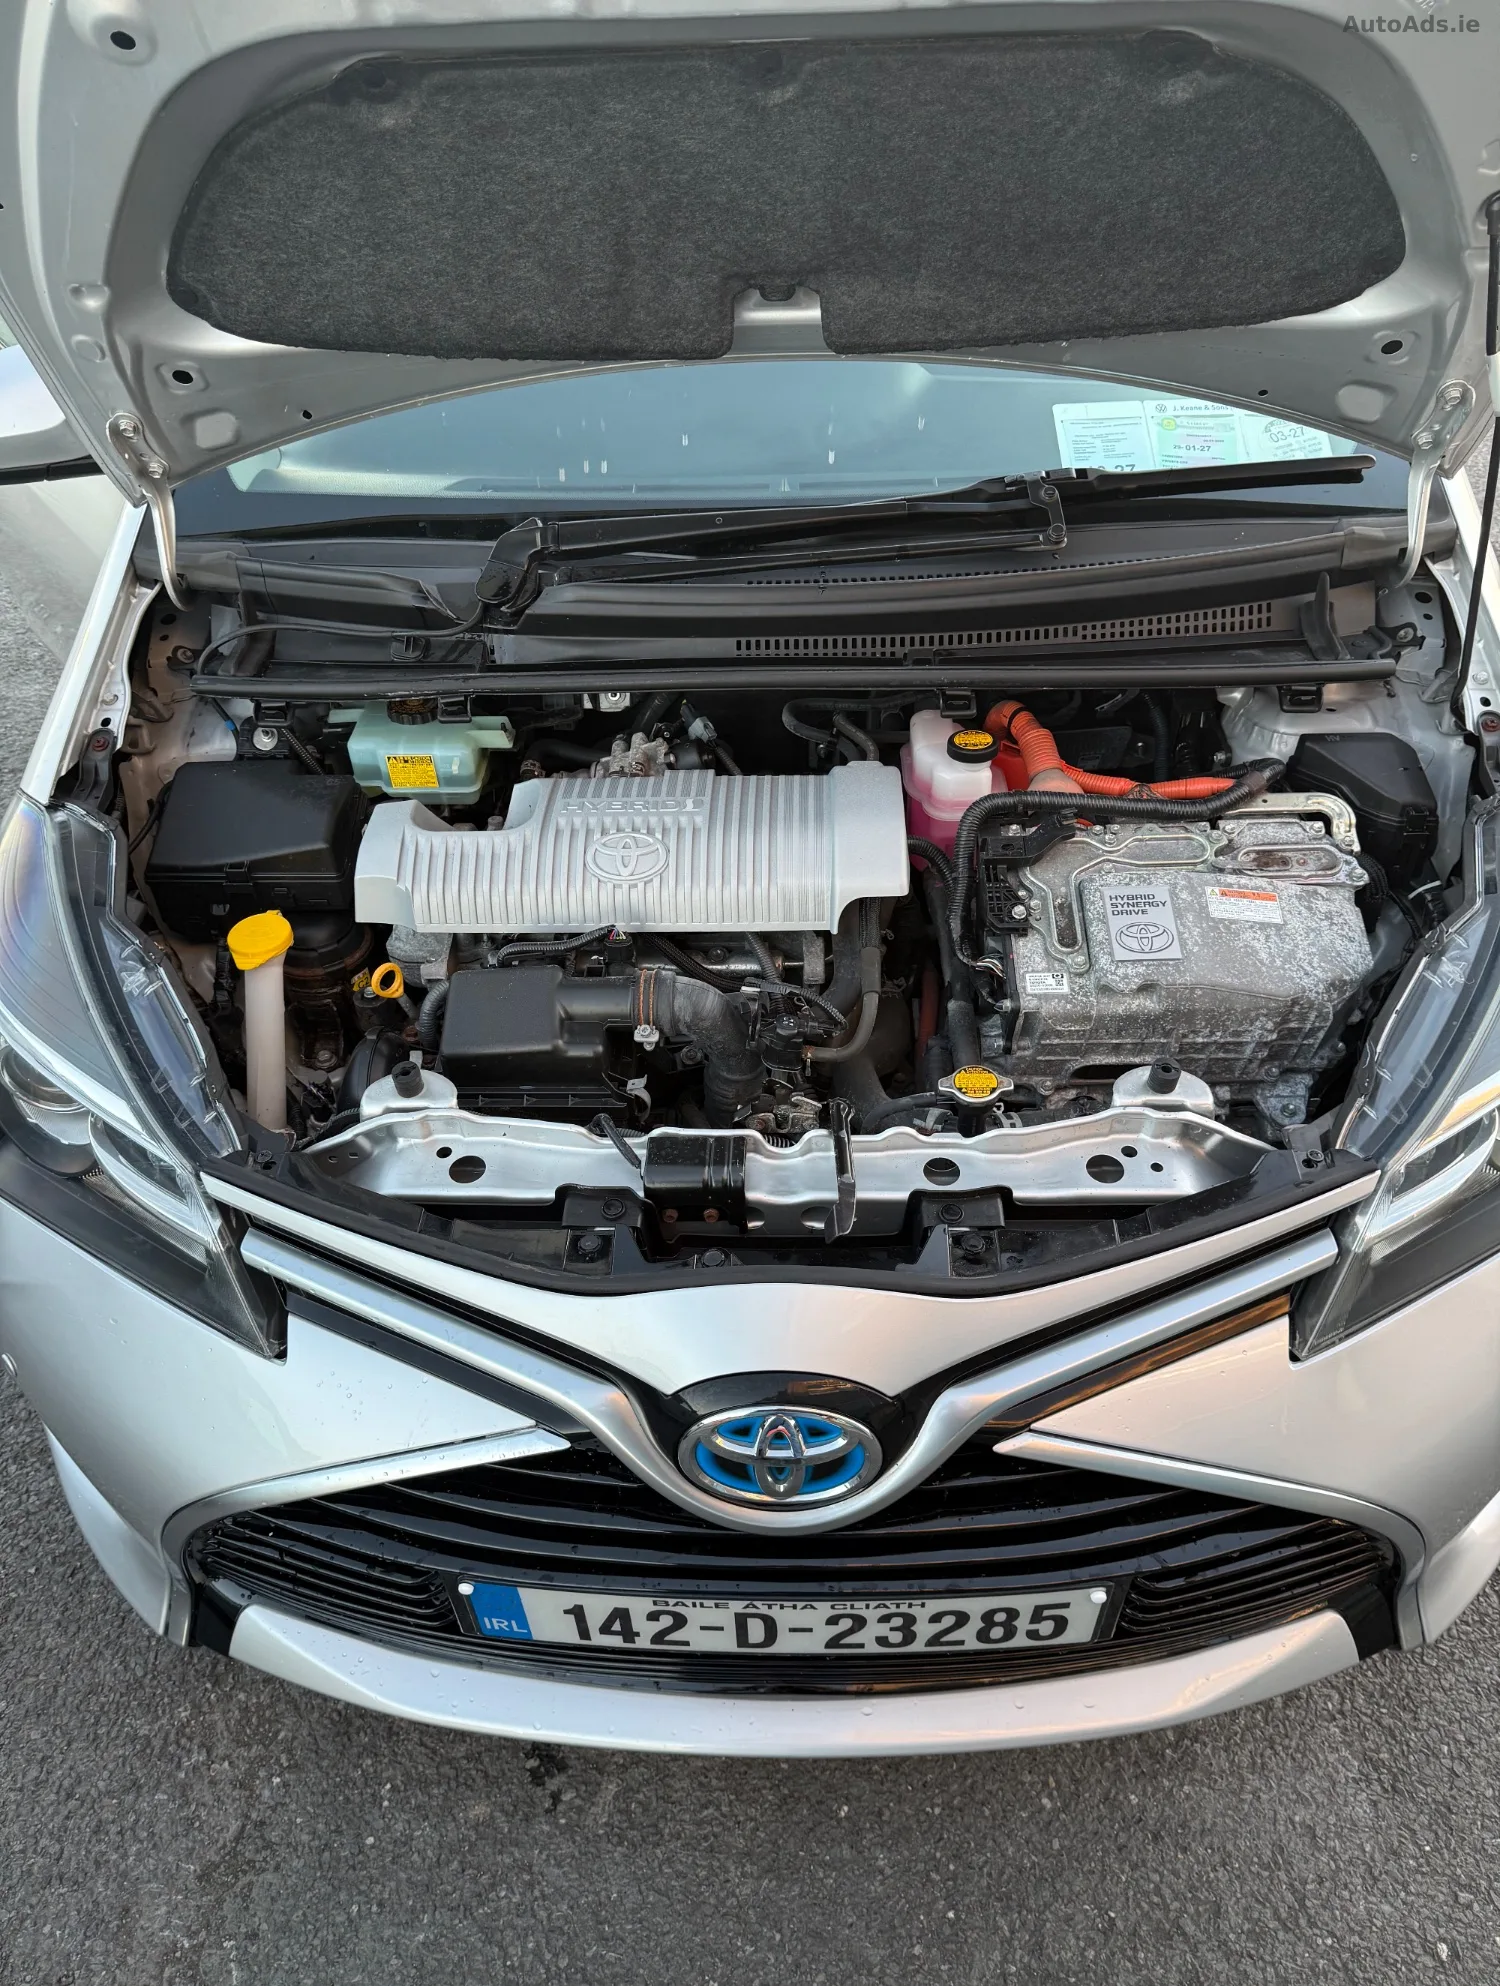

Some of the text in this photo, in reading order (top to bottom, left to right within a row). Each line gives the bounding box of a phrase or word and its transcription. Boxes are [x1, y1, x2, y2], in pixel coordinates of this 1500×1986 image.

[1180, 404, 1203, 412] Keane
[1269, 426, 1305, 443] 03-27
[1185, 444, 1212, 452] 01-27
[1109, 893, 1155, 901] HYBRID
[1110, 900, 1167, 909] SYNERGY
[652, 1600, 926, 1611] BAILE ÁTHA CLIATH
[483, 1616, 528, 1634] IRL
[562, 1602, 1071, 1650] 142-D-23285
